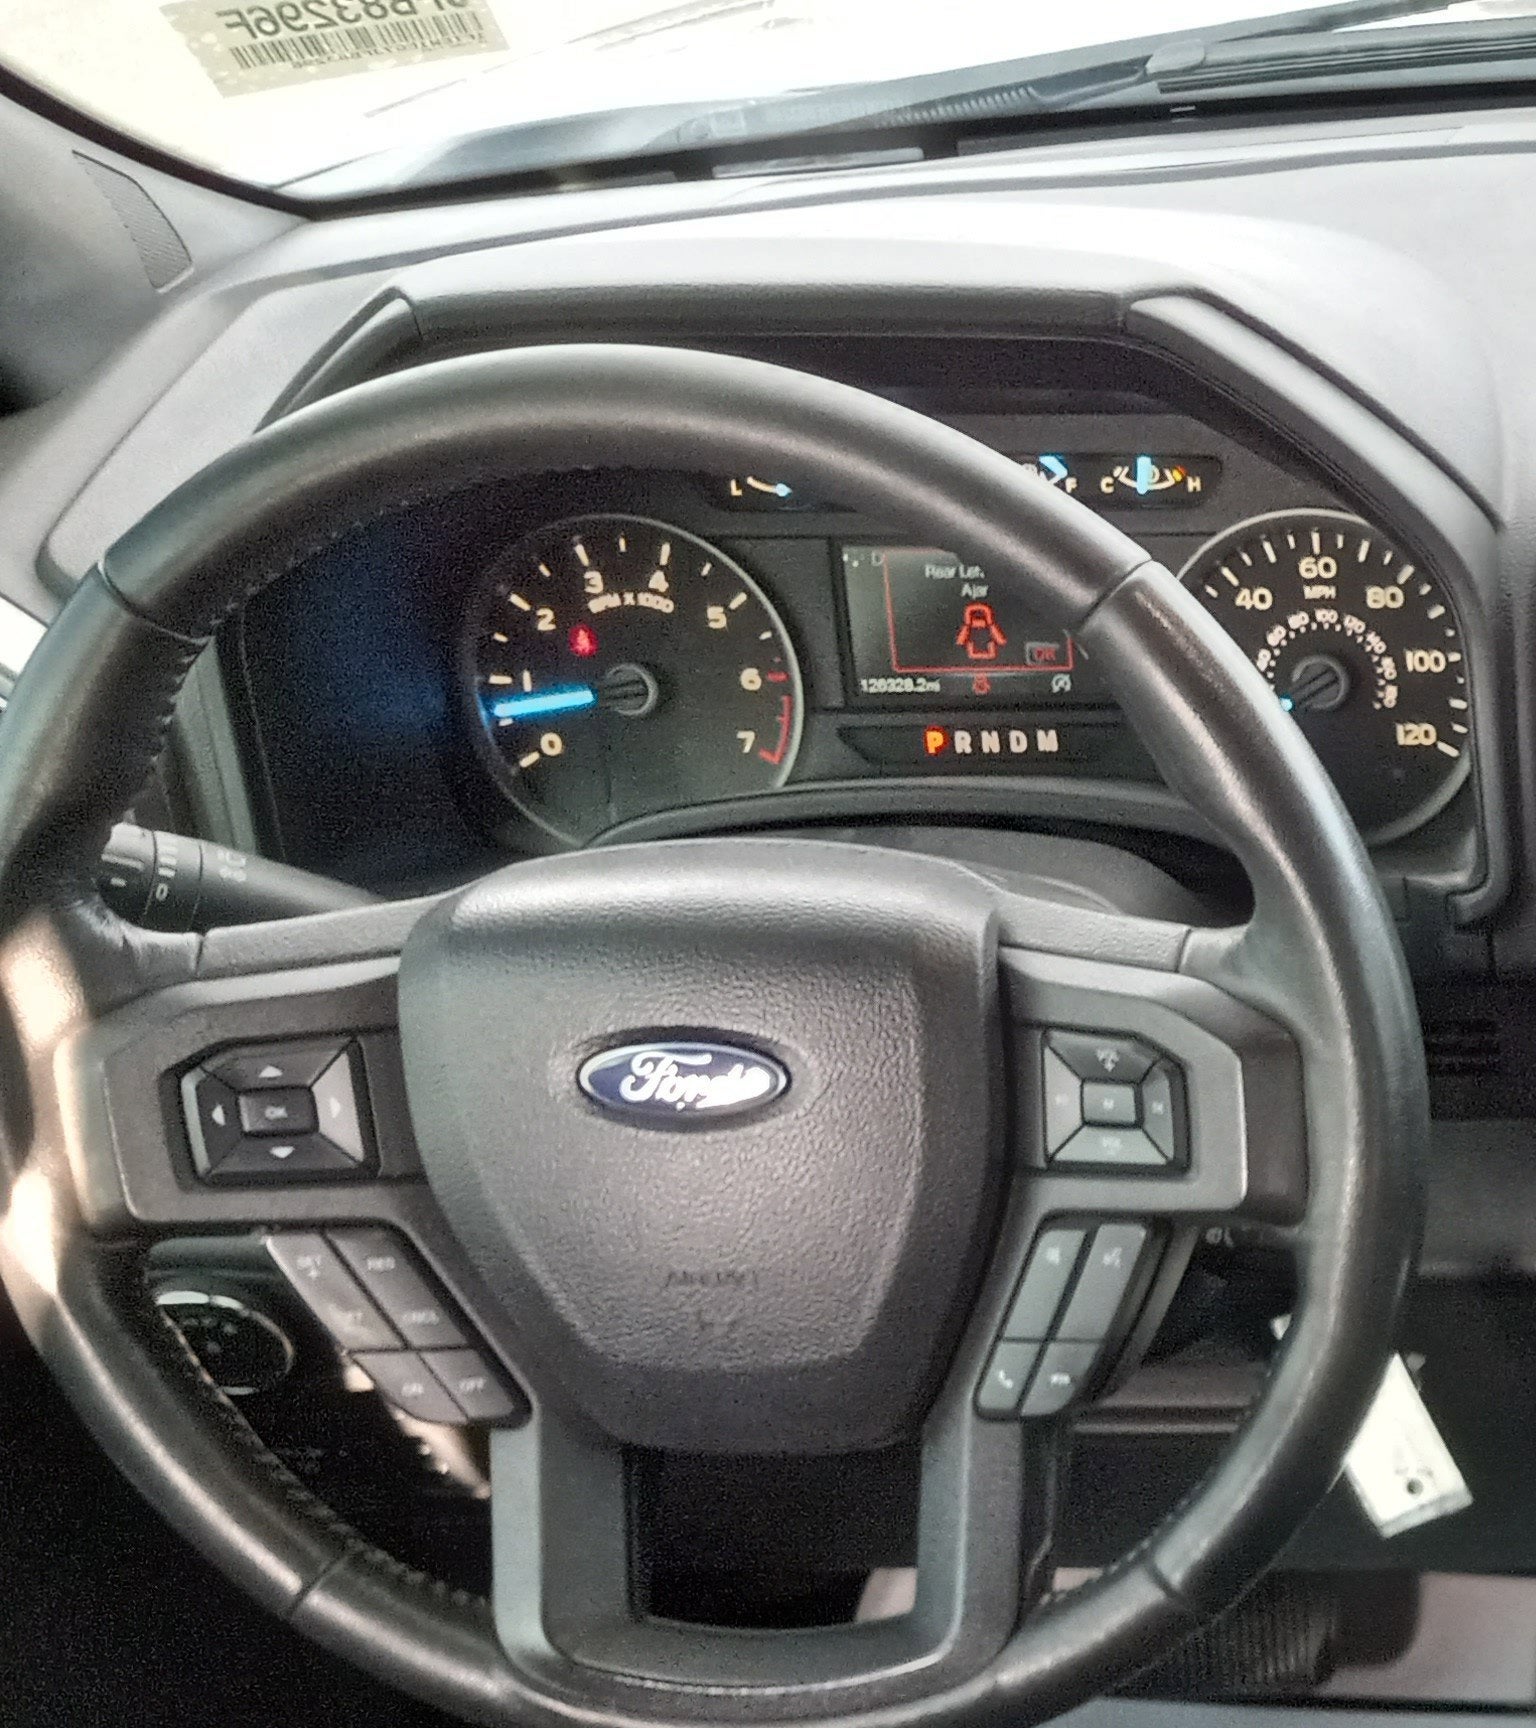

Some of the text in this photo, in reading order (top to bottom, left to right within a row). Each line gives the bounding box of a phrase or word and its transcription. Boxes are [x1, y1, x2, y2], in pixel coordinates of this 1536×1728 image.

[730, 479, 743, 496] L
[1064, 476, 1077, 493] F
[1101, 475, 1114, 494] C
[1188, 476, 1201, 492] H
[1298, 556, 1338, 579] 60
[585, 570, 603, 593] 3
[648, 570, 669, 592] 4
[1302, 585, 1337, 600] MPH
[1235, 587, 1273, 610] 40
[1365, 585, 1404, 610] 80
[535, 608, 556, 631] 2
[706, 605, 727, 629] 5
[1405, 650, 1446, 673] 100
[740, 667, 762, 691] 6
[540, 732, 562, 756] 0
[736, 730, 755, 753] 7
[926, 729, 1059, 754] P R N D M
[1396, 722, 1437, 746] 120
[619, 1050, 771, 1110] Ford
